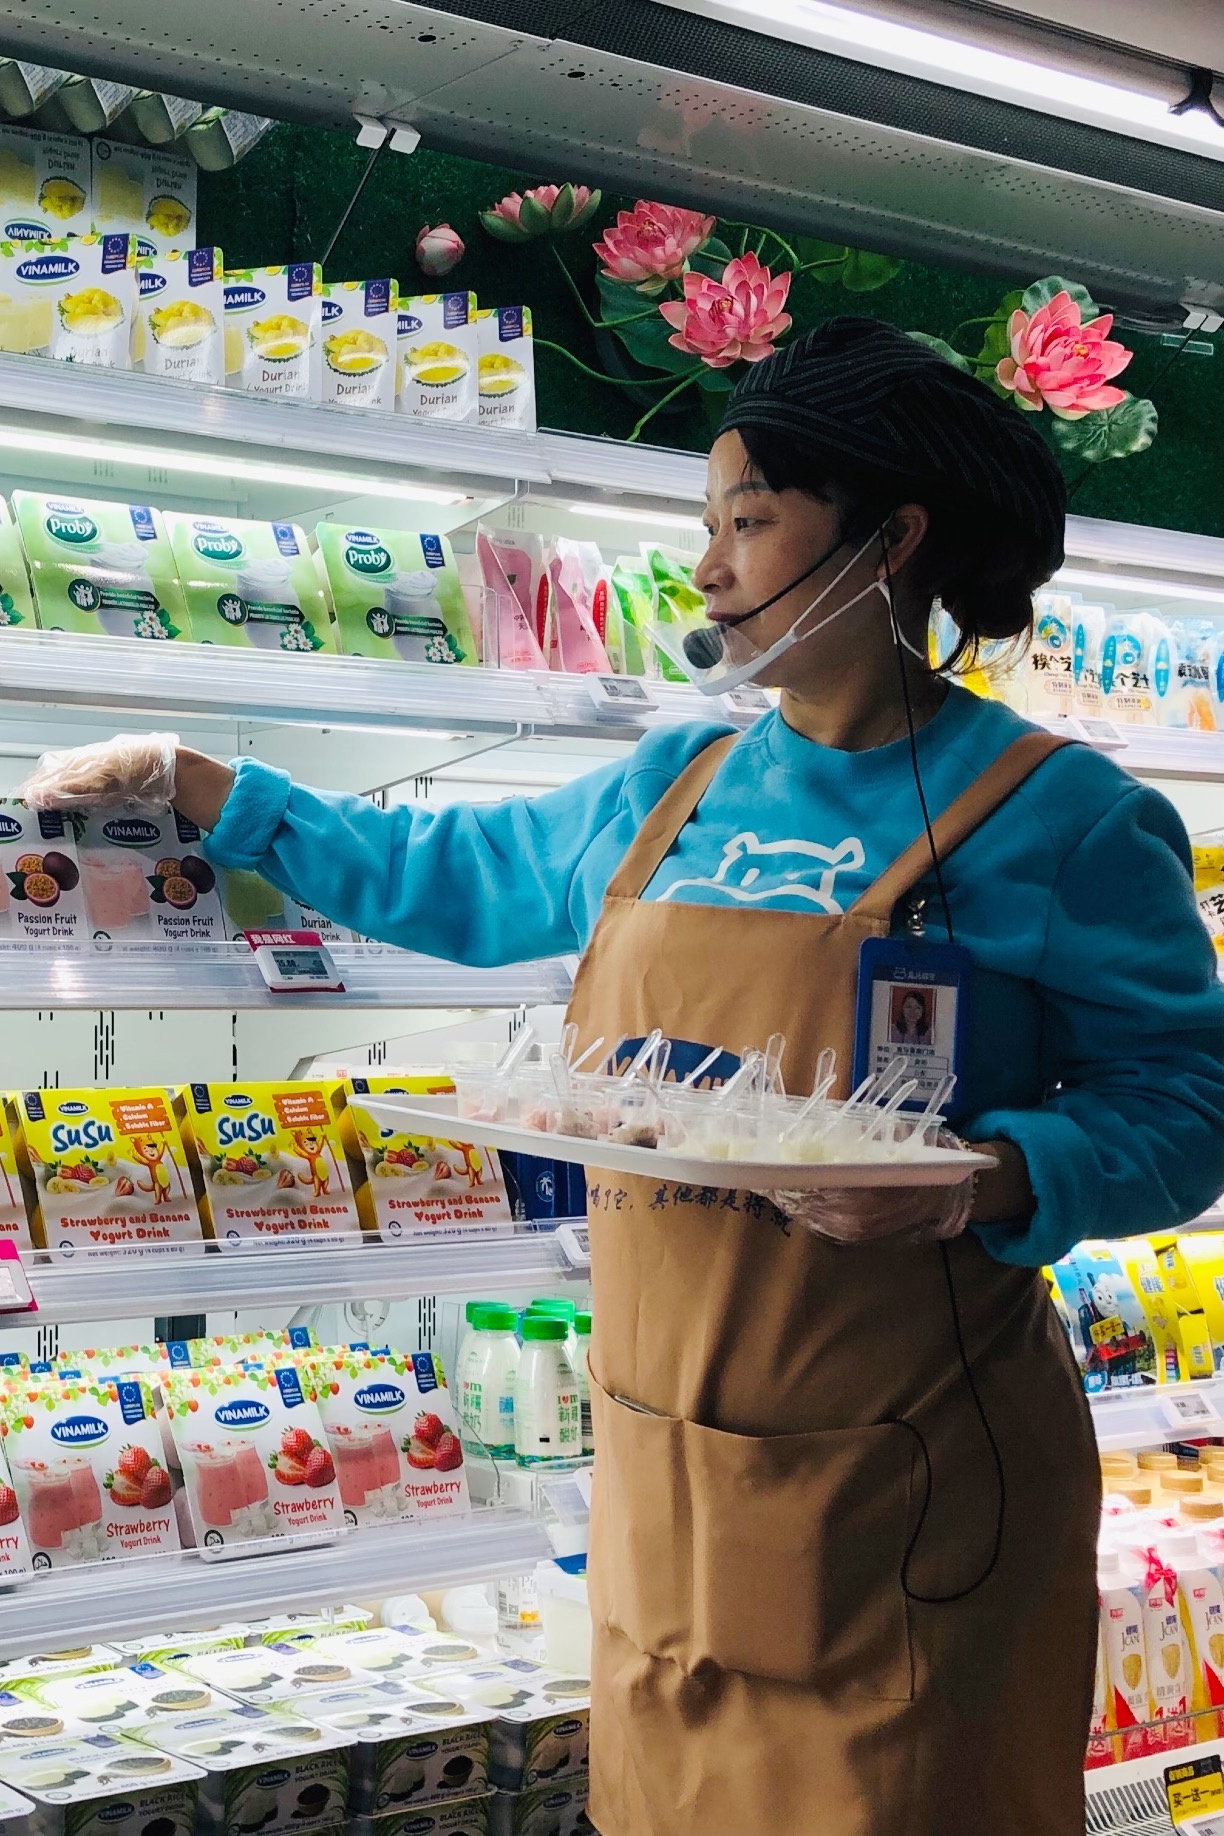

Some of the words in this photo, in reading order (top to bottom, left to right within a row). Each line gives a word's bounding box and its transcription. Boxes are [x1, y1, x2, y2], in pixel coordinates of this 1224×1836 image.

[21, 263, 76, 276] VINAMILK
[478, 404, 514, 416] Durian
[50, 517, 95, 539] Proby
[347, 533, 380, 545] VINAMILK
[197, 537, 239, 559] Proby
[349, 550, 388, 571] Proby
[106, 826, 157, 838] VINAMILK
[18, 913, 54, 924] Passion
[56, 913, 77, 925] Fruit
[158, 915, 190, 927] Passion
[192, 915, 214, 927] Fruit
[301, 916, 332, 928] Durian
[24, 926, 49, 938] Yogurt
[51, 926, 74, 936] Drink
[164, 928, 187, 939] Yogurt
[189, 928, 210, 938] Drink
[251, 933, 294, 945] 我是网红
[59, 1104, 88, 1113] VINAMILK
[224, 1097, 253, 1105] VINAMILK
[53, 1120, 112, 1152] SuSu
[218, 1114, 275, 1145] SuSu
[388, 1198, 446, 1211] Strawberry
[447, 1197, 463, 1205] and
[466, 1195, 500, 1204] Banana
[61, 1215, 126, 1229] Strawberry
[128, 1214, 148, 1223] and
[150, 1212, 190, 1223] Banana
[226, 1208, 290, 1222] Strawberry
[292, 1207, 308, 1216] and
[310, 1205, 348, 1215] Banana
[414, 1210, 452, 1223] Yogurt
[454, 1208, 483, 1219] Drink
[254, 1221, 295, 1234] Yogurt
[297, 1219, 330, 1230] Drink
[89, 1230, 133, 1244] Yogurt
[136, 1228, 170, 1238] Drink
[357, 1391, 403, 1405] VINAMILK
[218, 1406, 268, 1421] VINAMILK
[54, 1423, 107, 1438] VINAMILK
[404, 1481, 462, 1498] Strawberry
[274, 1497, 335, 1516] Strawberry
[106, 1518, 170, 1538] Strawberry
[287, 1516, 308, 1528] Yogurt
[309, 1513, 327, 1523] Drink
[120, 1538, 142, 1549] Yogurt
[144, 1534, 162, 1544] Drink
